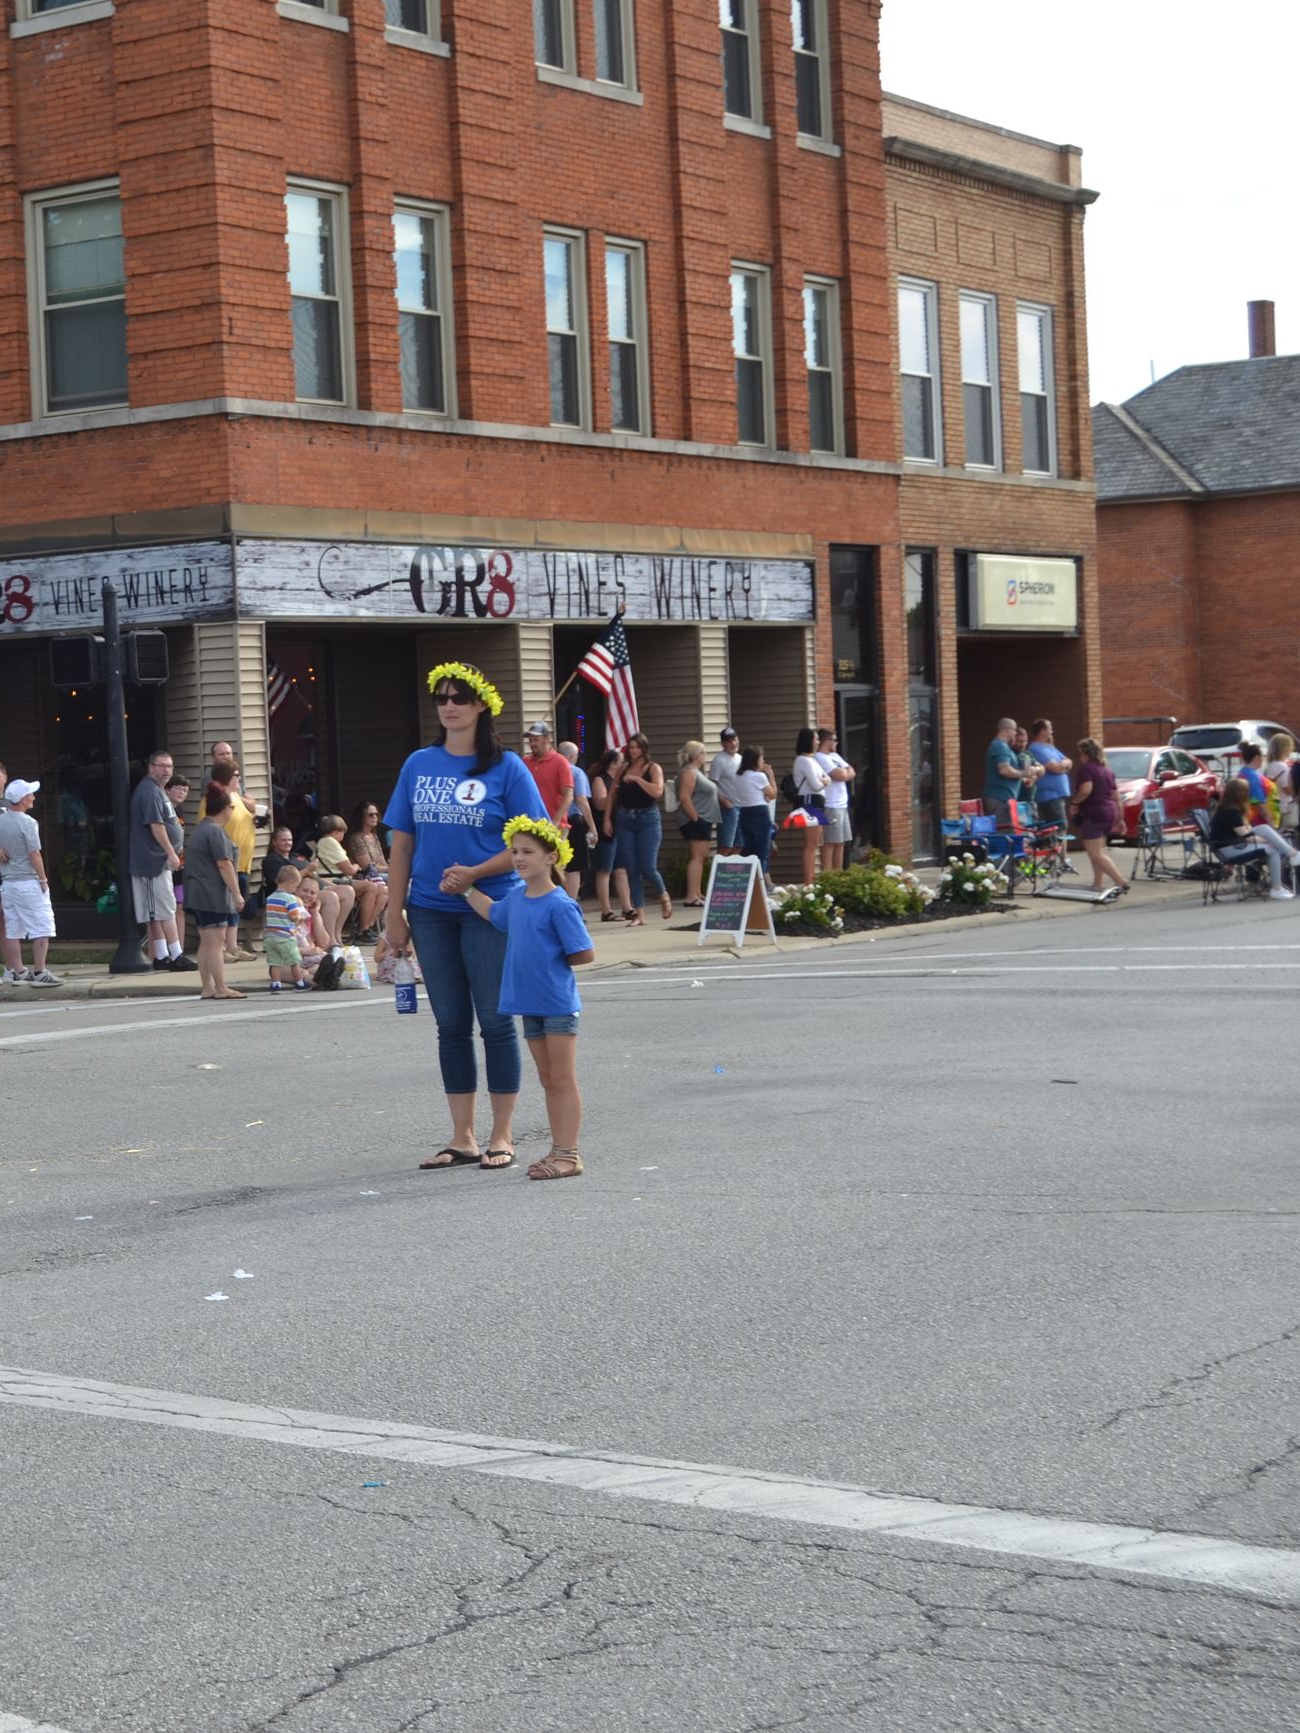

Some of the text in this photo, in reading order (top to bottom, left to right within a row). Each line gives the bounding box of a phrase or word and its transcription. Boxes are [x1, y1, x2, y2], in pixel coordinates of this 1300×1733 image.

[410, 546, 753, 621] GR8 VINES WINERY
[1019, 581, 1055, 595] SPHERION
[51, 575, 111, 616] VINE
[123, 566, 210, 609] WINERY
[415, 776, 457, 789] PLUS
[413, 789, 453, 804] ONE
[438, 813, 483, 827] ESTATE
